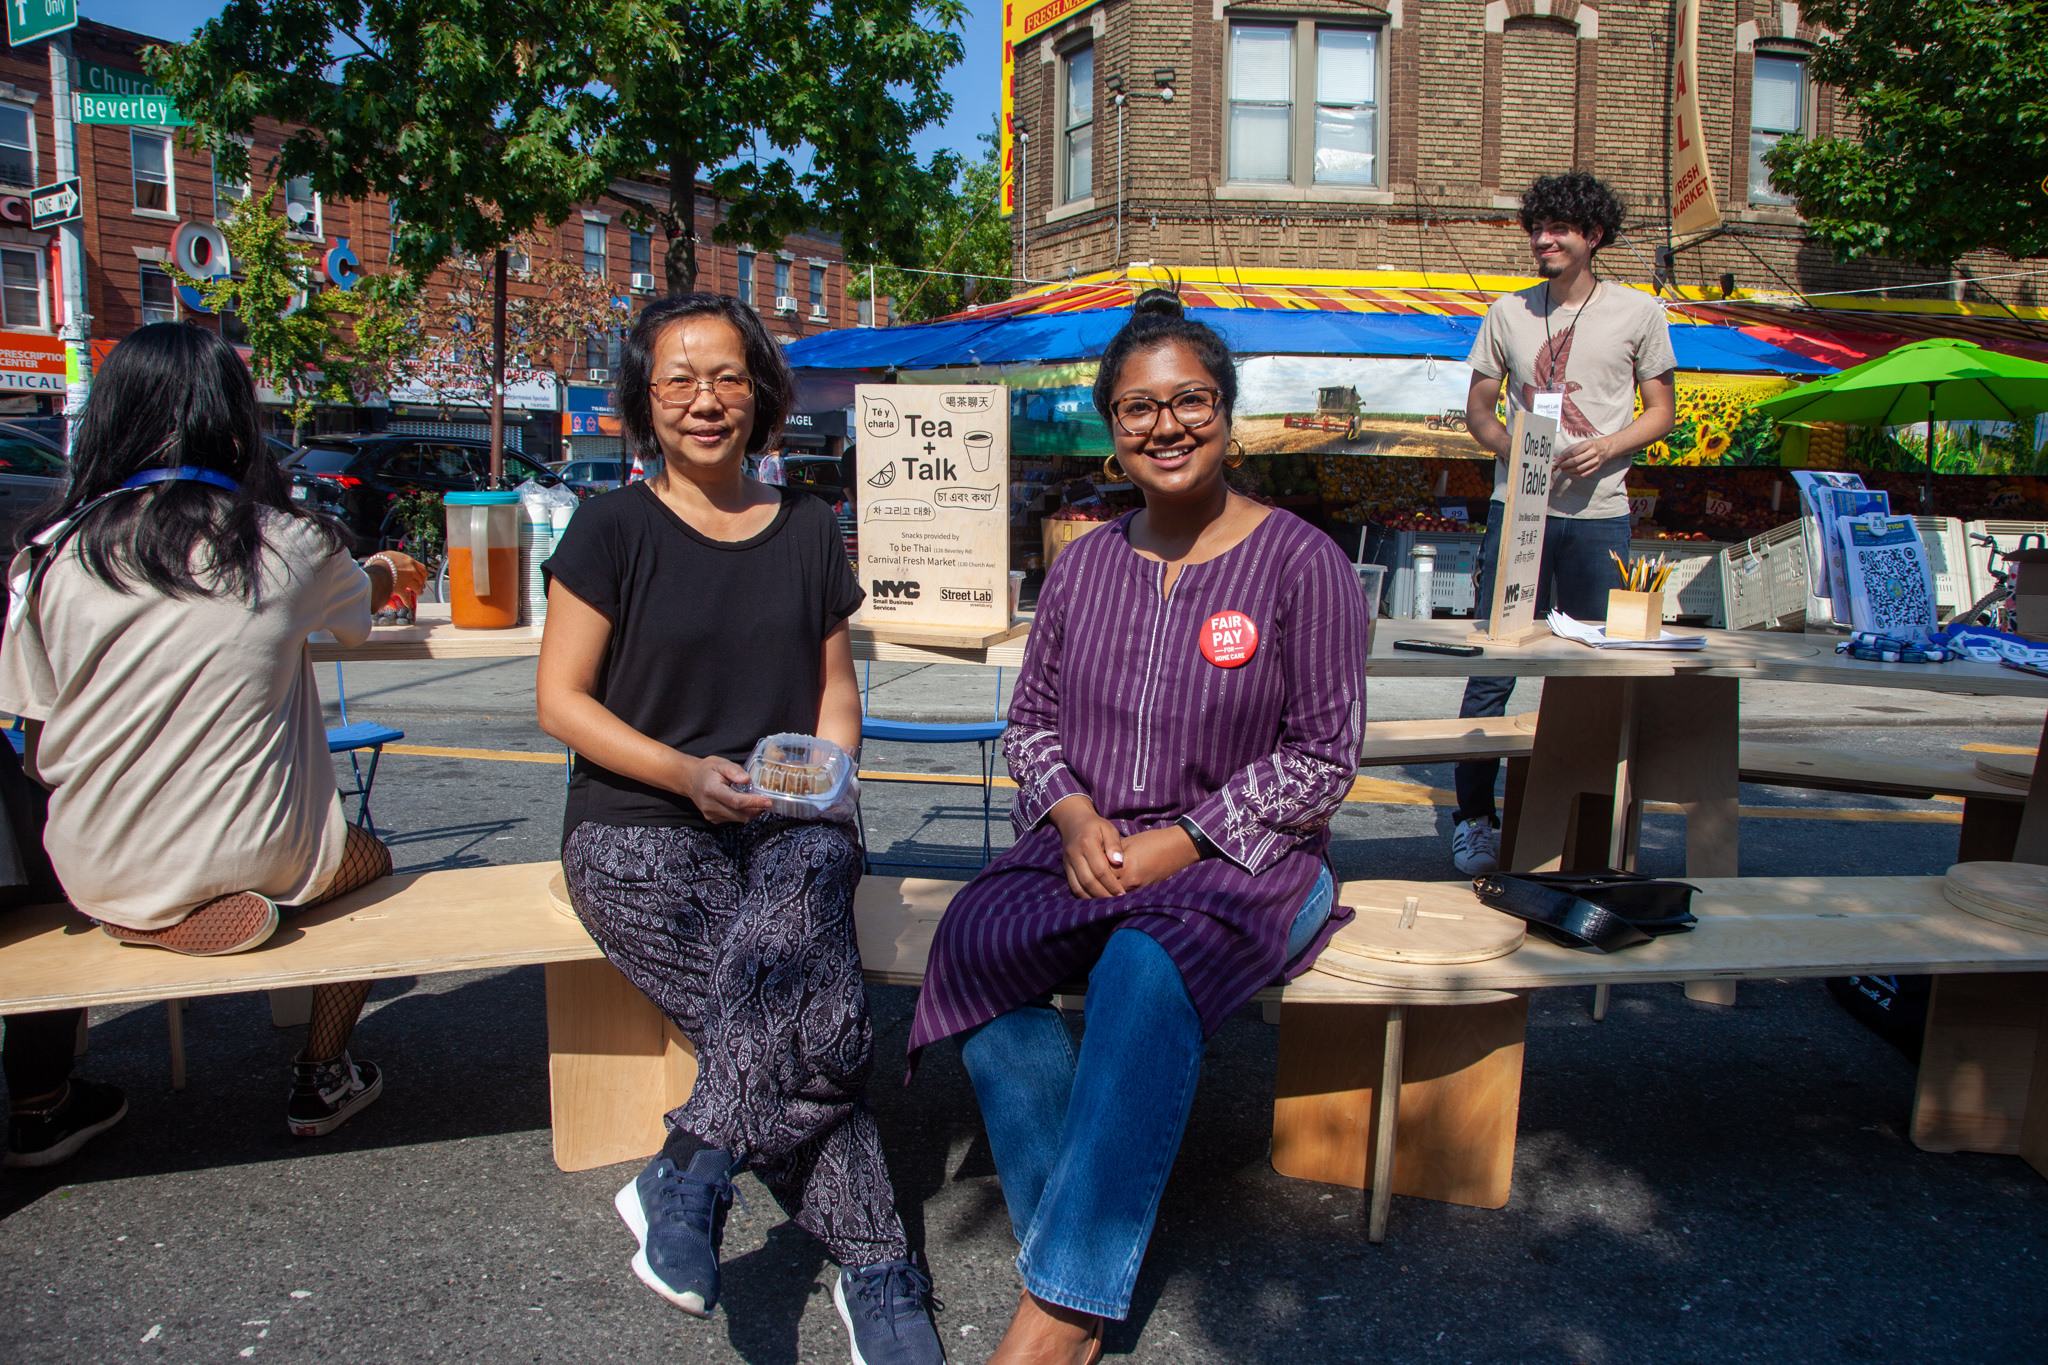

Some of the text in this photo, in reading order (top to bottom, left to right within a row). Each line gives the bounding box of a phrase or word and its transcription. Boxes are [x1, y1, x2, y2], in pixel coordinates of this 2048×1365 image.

[1026, 1, 1061, 32] FRESH
[84, 97, 167, 124] Beverley
[1675, 163, 1700, 197] FRESH
[38, 191, 74, 214] ONE WAY
[1673, 176, 1708, 219] MARKET
[0, 358, 38, 368] CENTER
[946, 396, 989, 408] 喝茶聊天
[872, 408, 882, 416] Té
[868, 420, 894, 428] charla
[904, 414, 952, 438] Tea
[1524, 432, 1551, 464] One Big
[902, 457, 957, 481] Talk
[1521, 462, 1547, 496] Table
[873, 506, 931, 516] 차 그리고 대화
[924, 532, 950, 541] provided
[951, 533, 960, 541] by
[889, 543, 899, 552] To
[901, 543, 911, 552] be
[913, 544, 932, 553] Thai
[867, 555, 901, 564] Carnival
[903, 556, 925, 565] Fresh
[927, 557, 956, 567] Market
[872, 580, 920, 599] NYC
[941, 589, 992, 602] Street Lab
[1504, 583, 1520, 604] NYC
[1211, 615, 1242, 631] FAIR
[1212, 629, 1242, 647] PAY
[1214, 652, 1245, 662] HOME CARE
